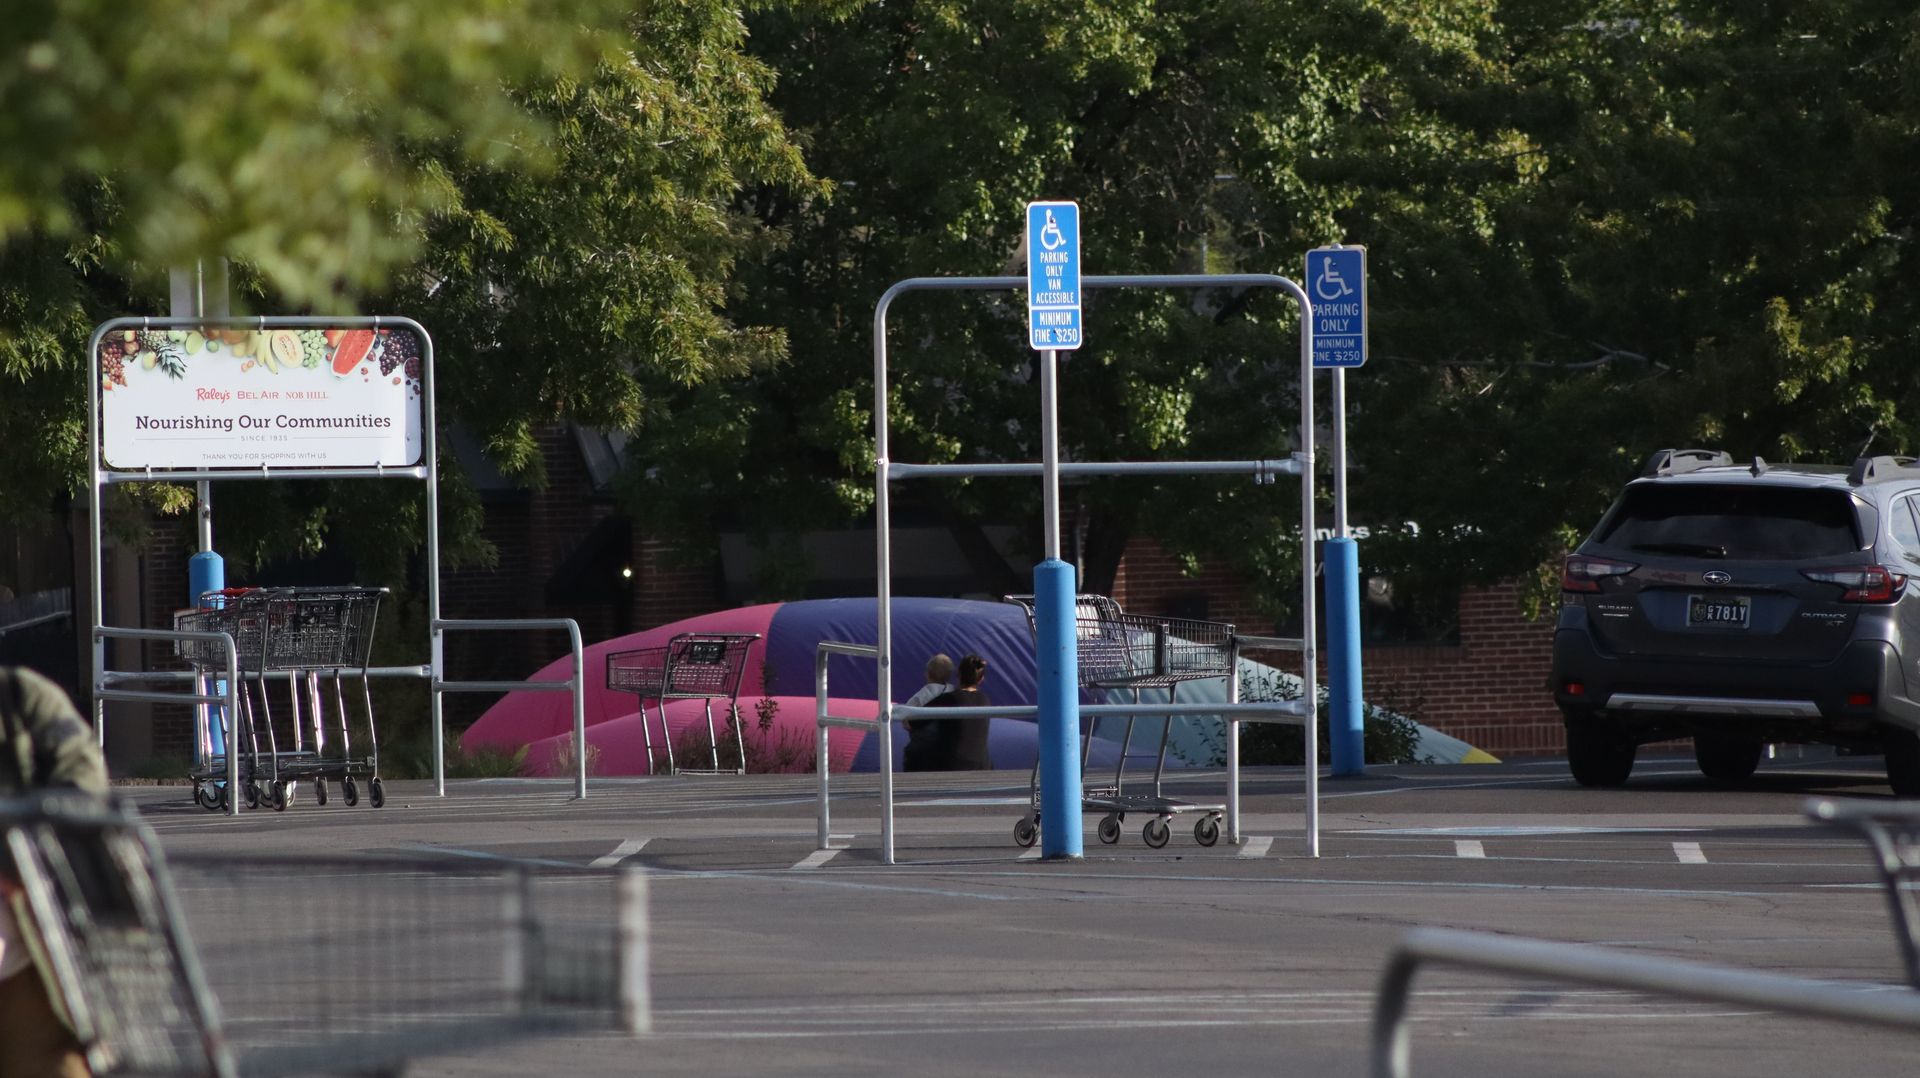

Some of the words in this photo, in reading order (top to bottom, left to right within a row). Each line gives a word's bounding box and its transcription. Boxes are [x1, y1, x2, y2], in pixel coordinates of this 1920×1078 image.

[1040, 251, 1068, 263] PARKING
[1046, 265, 1063, 277] ONLY
[1048, 279, 1061, 290] VAN
[1036, 292, 1074, 304] ACCESSIBLE
[1312, 303, 1359, 317] PARKING
[1040, 312, 1072, 325] MINIMUM
[1321, 319, 1349, 332] ONLY
[1035, 329, 1050, 342] FINE
[1056, 328, 1078, 342] $250
[1316, 338, 1355, 349] MINIMUM
[1335, 350, 1360, 361] $250
[196, 387, 231, 403] Raley's
[237, 391, 258, 399] BEL
[260, 391, 280, 399] AIR
[285, 391, 304, 399] NOB
[306, 391, 329, 399] HILL
[136, 415, 233, 432] Nourishing
[238, 414, 271, 429] Our
[275, 413, 392, 428] Communities
[1715, 606, 1746, 621] 781Y
